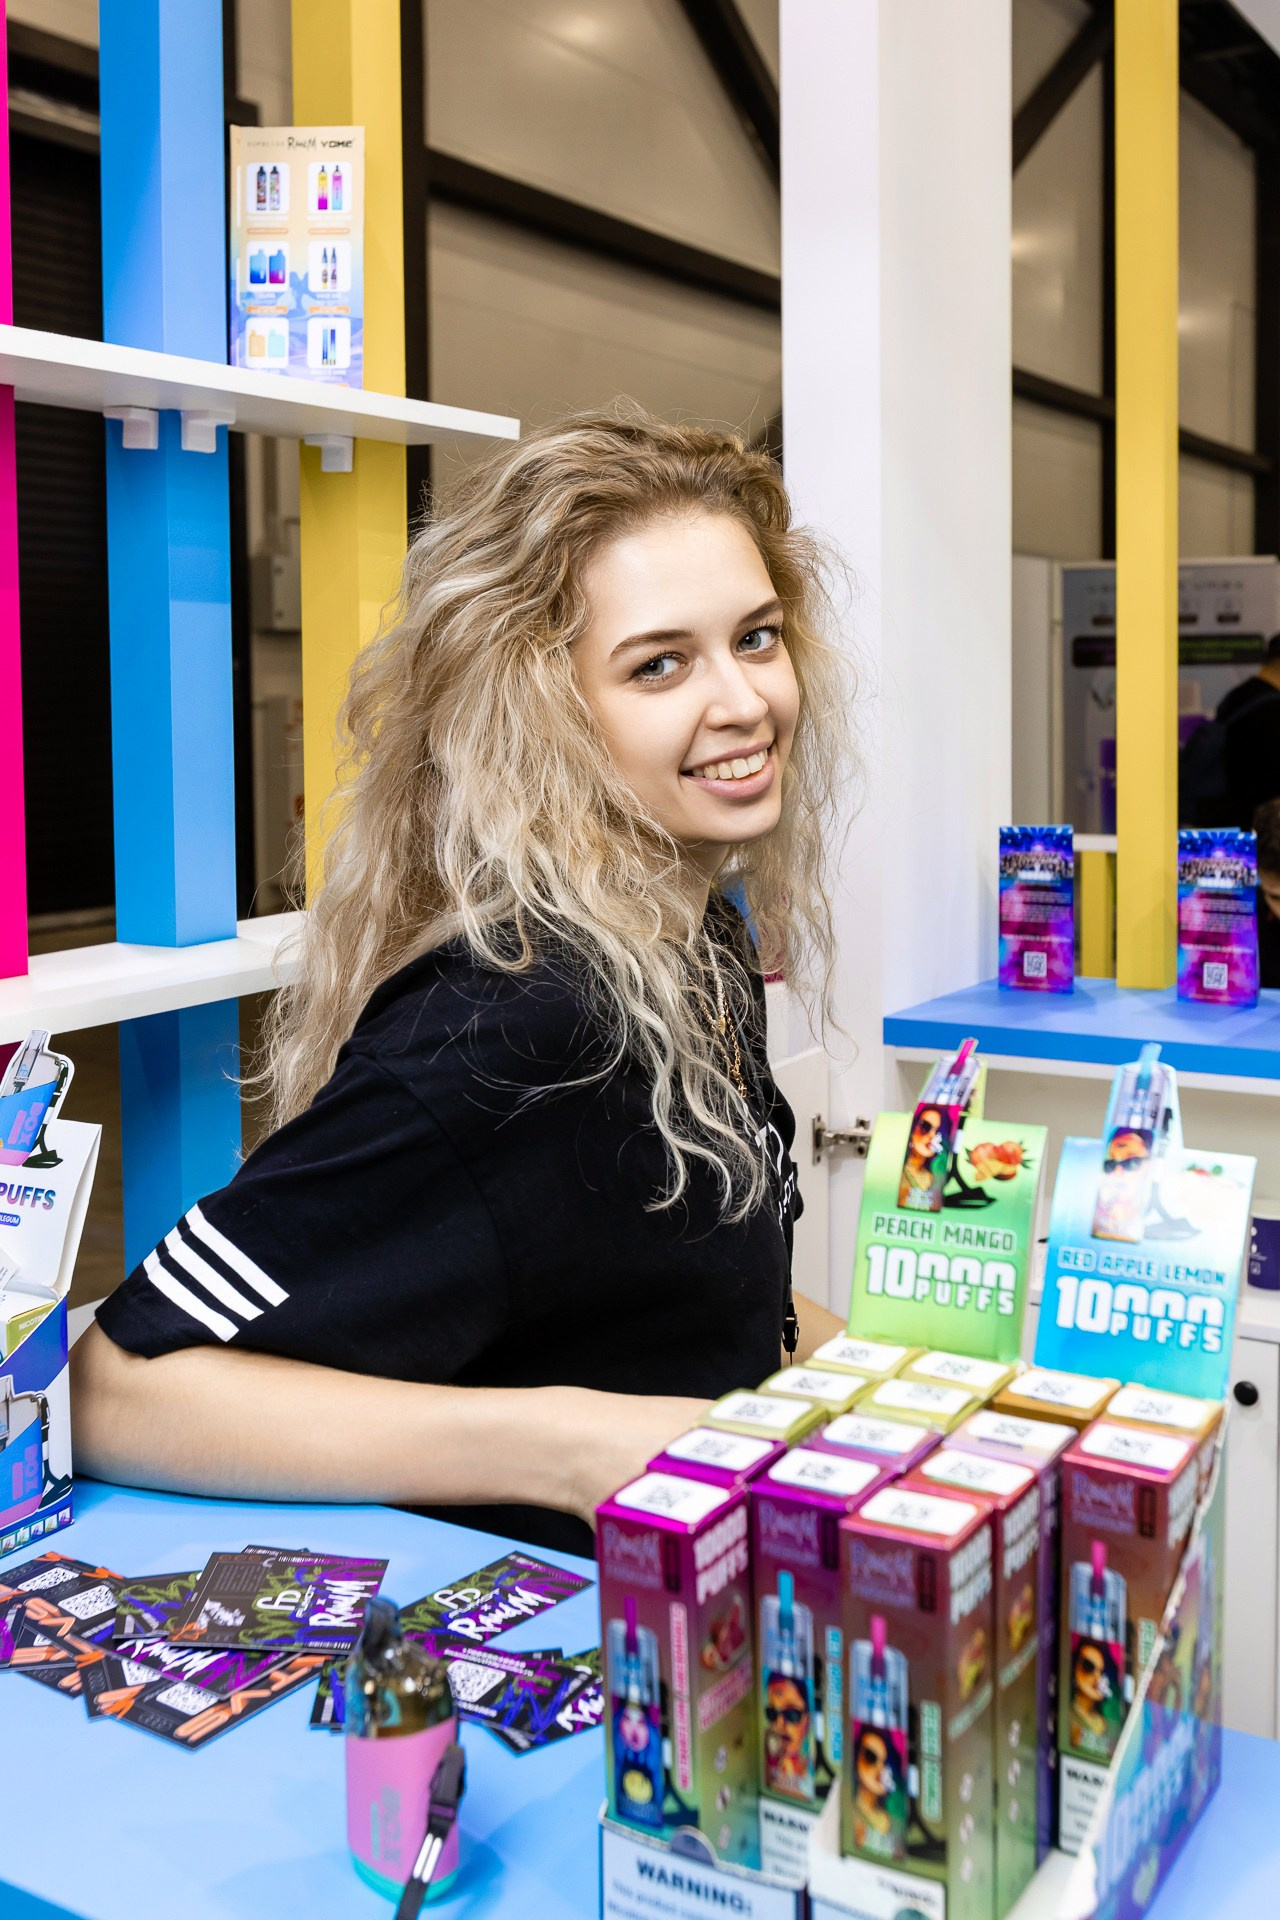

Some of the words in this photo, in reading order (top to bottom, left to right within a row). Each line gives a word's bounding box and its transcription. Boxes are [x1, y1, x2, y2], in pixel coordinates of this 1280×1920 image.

[875, 1215, 933, 1240] PEACH
[943, 1225, 1013, 1251] MANGO
[1062, 1249, 1093, 1268] RED
[1103, 1255, 1154, 1278] APPLE
[1165, 1263, 1226, 1287] LEMON
[914, 1278, 1015, 1317] PUFFS
[1109, 1311, 1223, 1354] PUFFS
